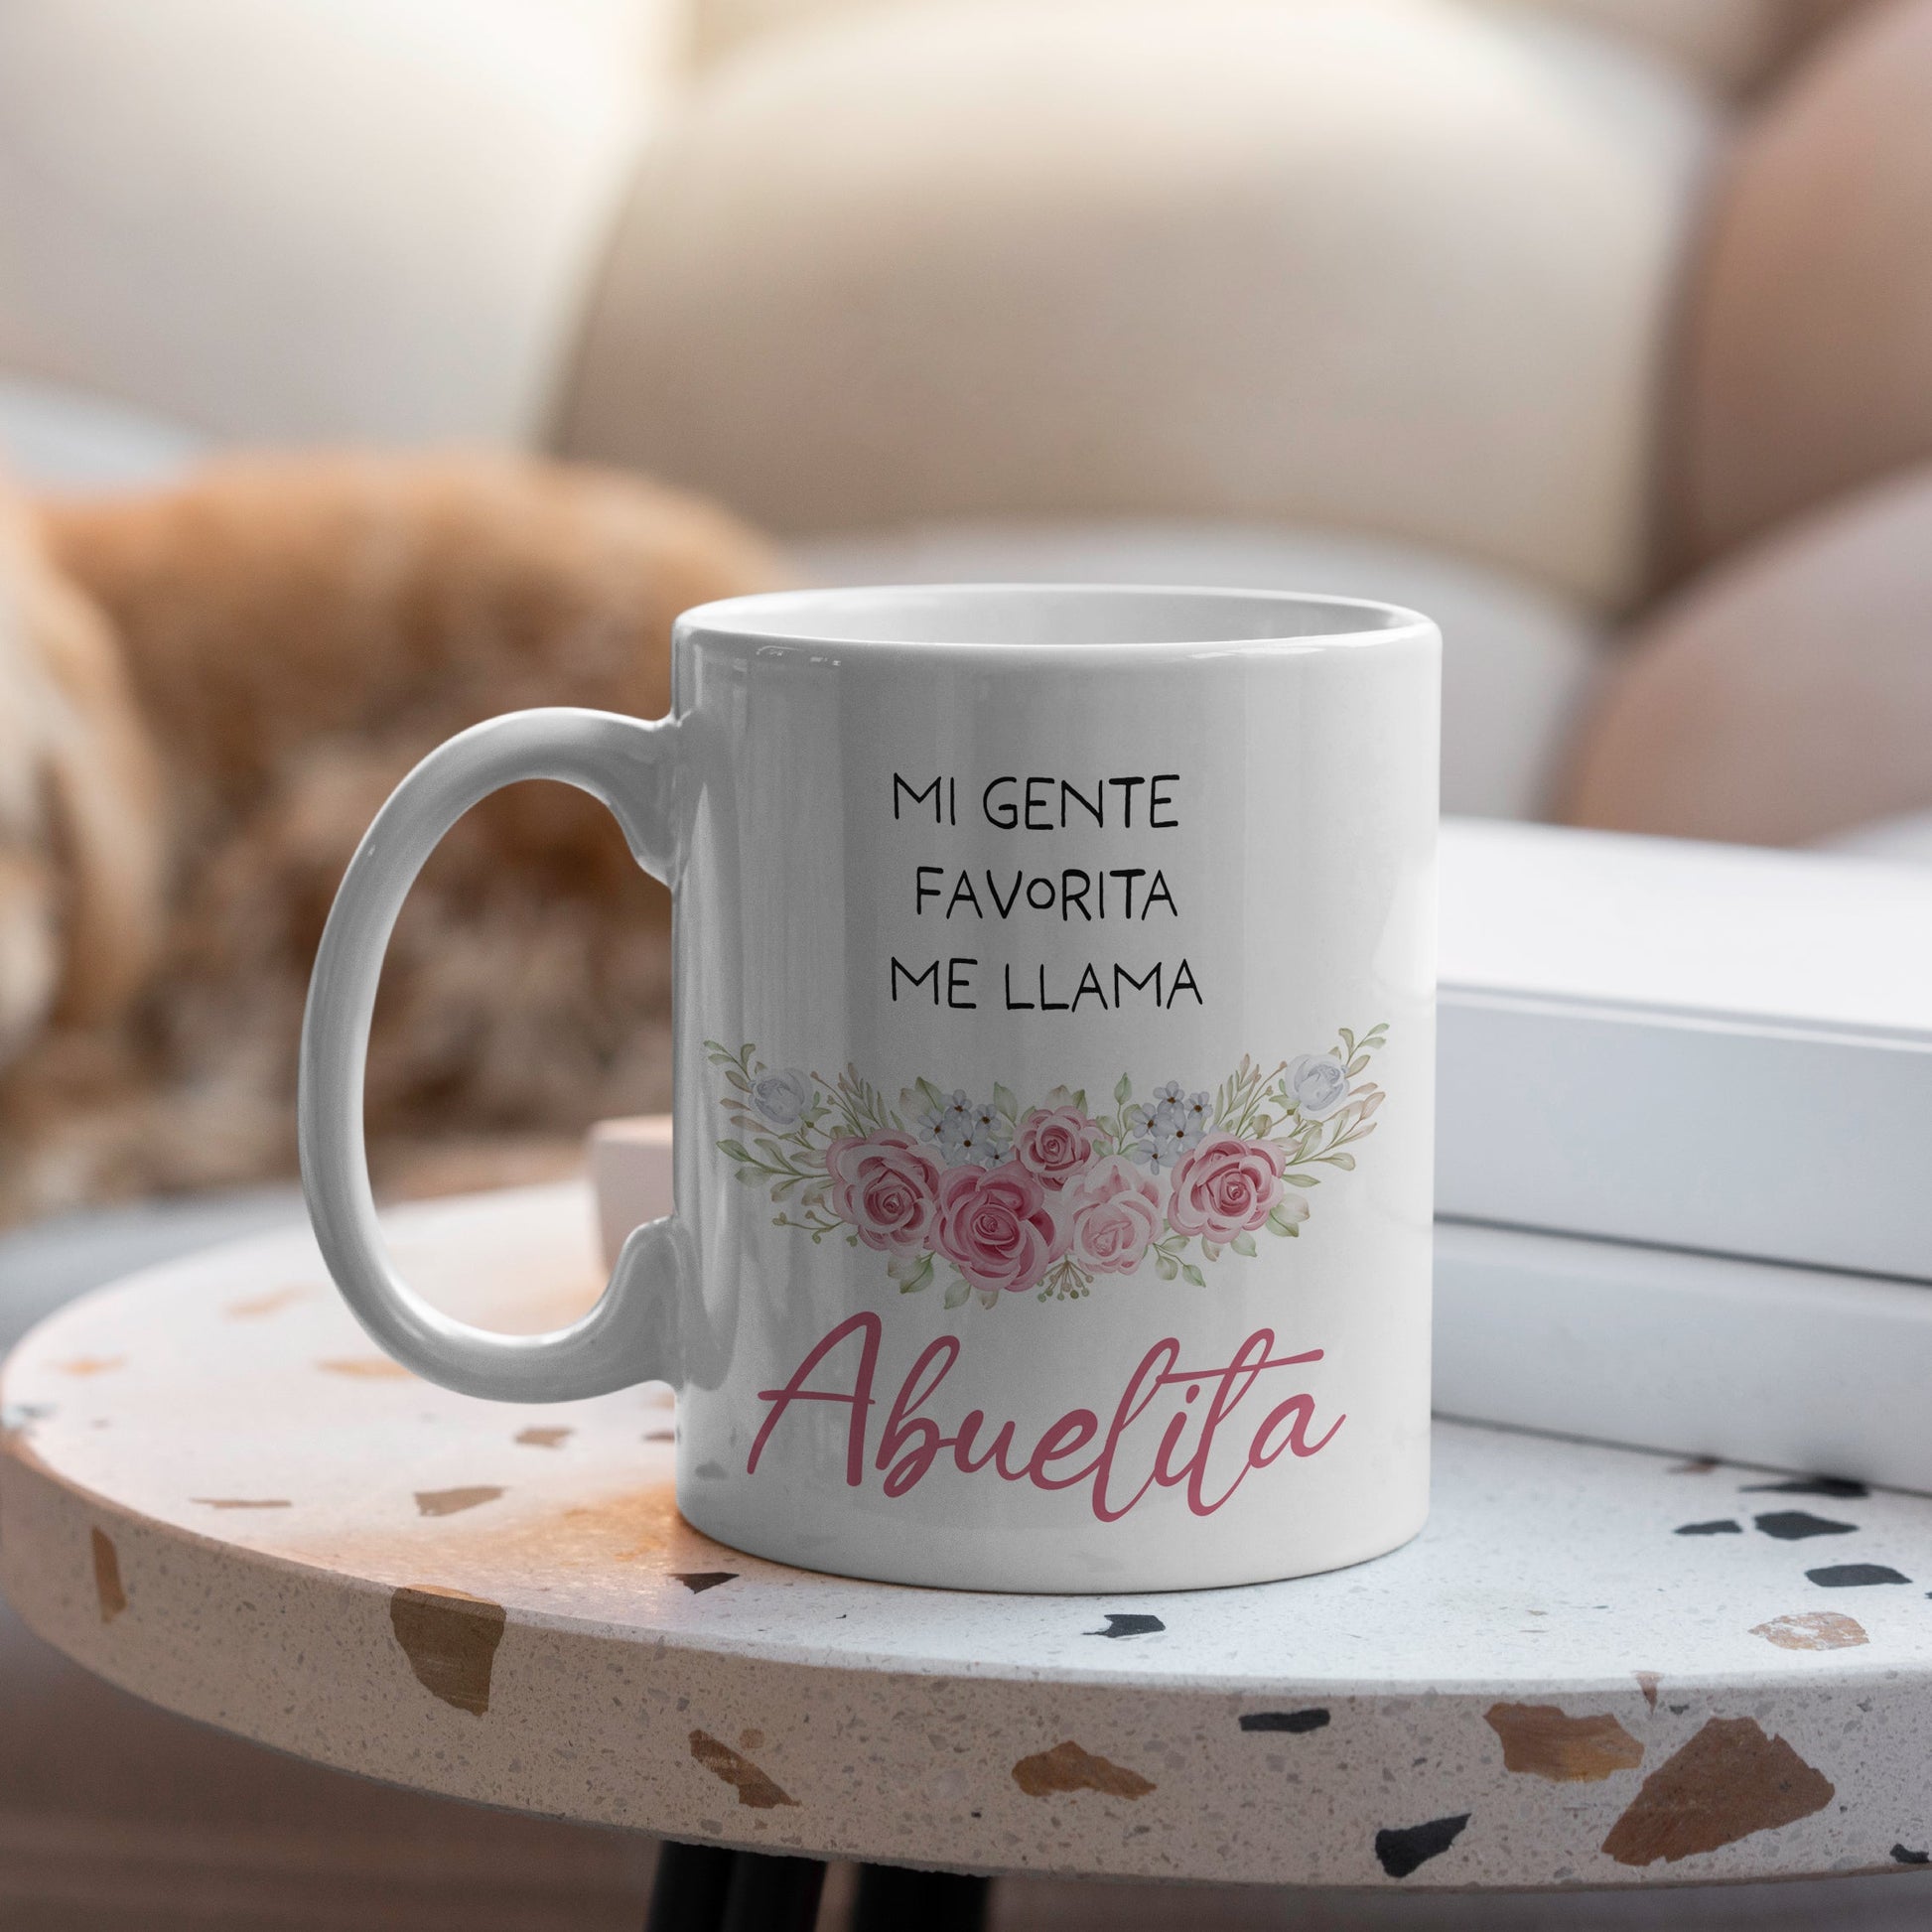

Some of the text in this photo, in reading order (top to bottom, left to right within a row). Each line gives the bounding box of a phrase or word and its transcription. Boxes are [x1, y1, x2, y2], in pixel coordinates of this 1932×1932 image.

[893, 771, 1180, 831] MI GENTE
[891, 955, 1203, 1013] ME LLAMA
[747, 1311, 1346, 1524] Abuelita
